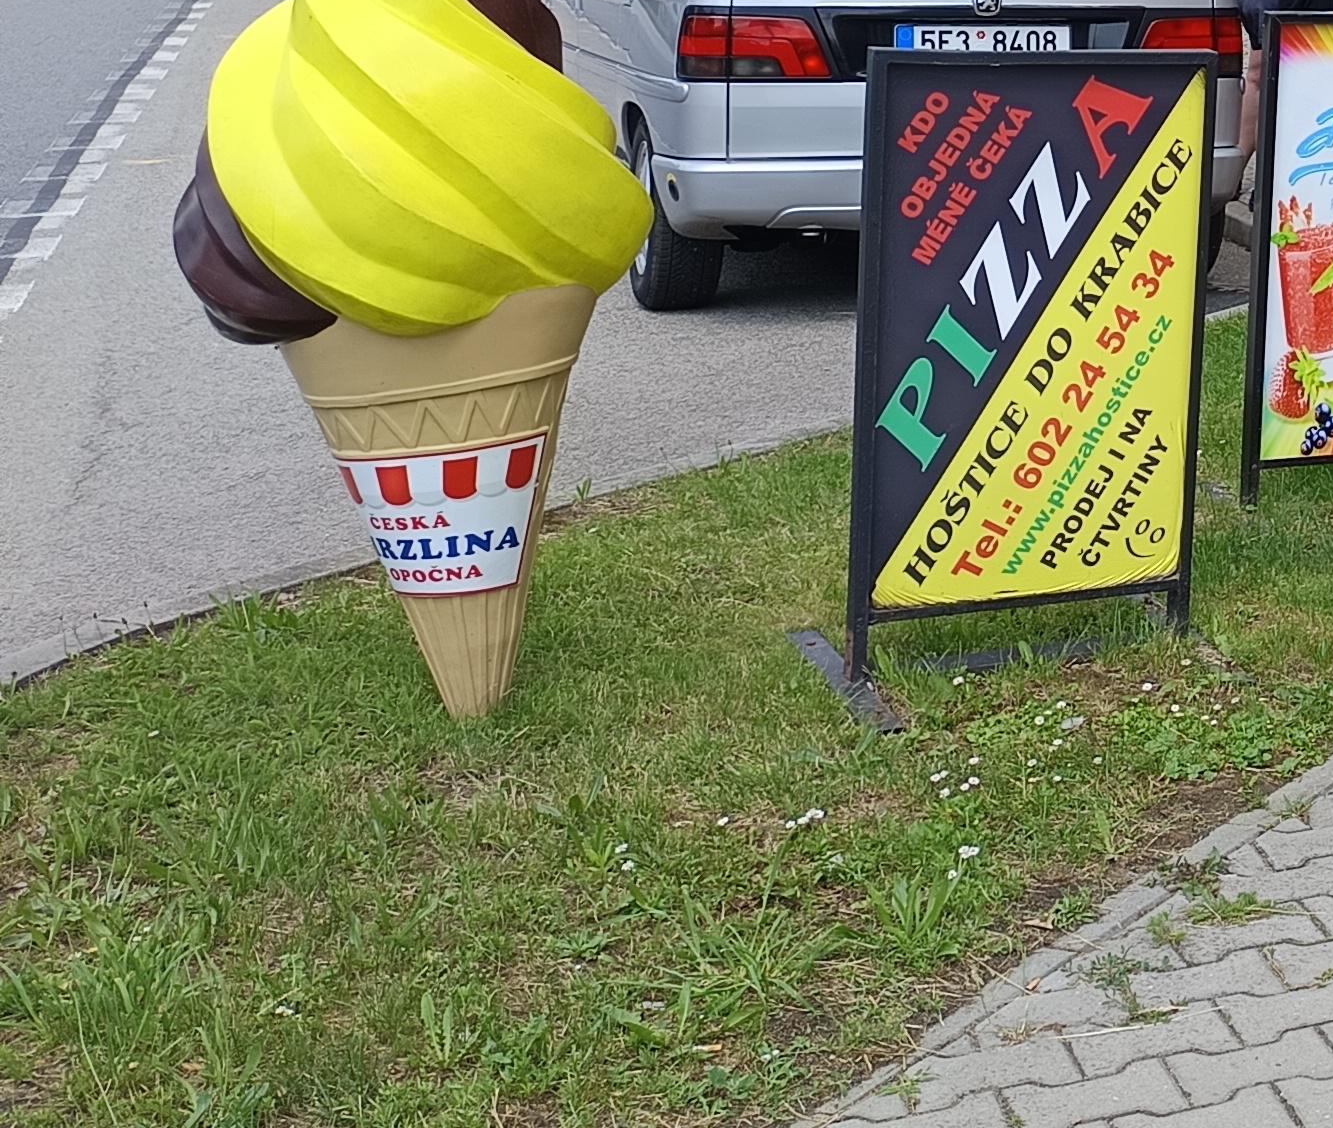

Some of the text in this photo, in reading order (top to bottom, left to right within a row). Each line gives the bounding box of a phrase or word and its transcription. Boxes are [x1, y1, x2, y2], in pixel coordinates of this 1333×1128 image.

[992, 30, 1057, 52] 8408
[897, 91, 950, 154] KDO
[901, 89, 1001, 219] OBJEDNÁ
[911, 105, 1033, 266] MÉNĚ ČEKÁ
[874, 74, 1154, 473] PIZZA
[902, 138, 1193, 587] HOŠTICE DO KRABICE
[950, 249, 1175, 578] Tel.: 602 24 54 34
[1001, 314, 1173, 576] www.pizzahostice.cz
[1039, 407, 1153, 570] PRODEJ I NA
[1078, 434, 1169, 567] ČTVRTINY
[369, 511, 451, 531] ČESKÁ
[389, 565, 484, 583] OPOČNA
